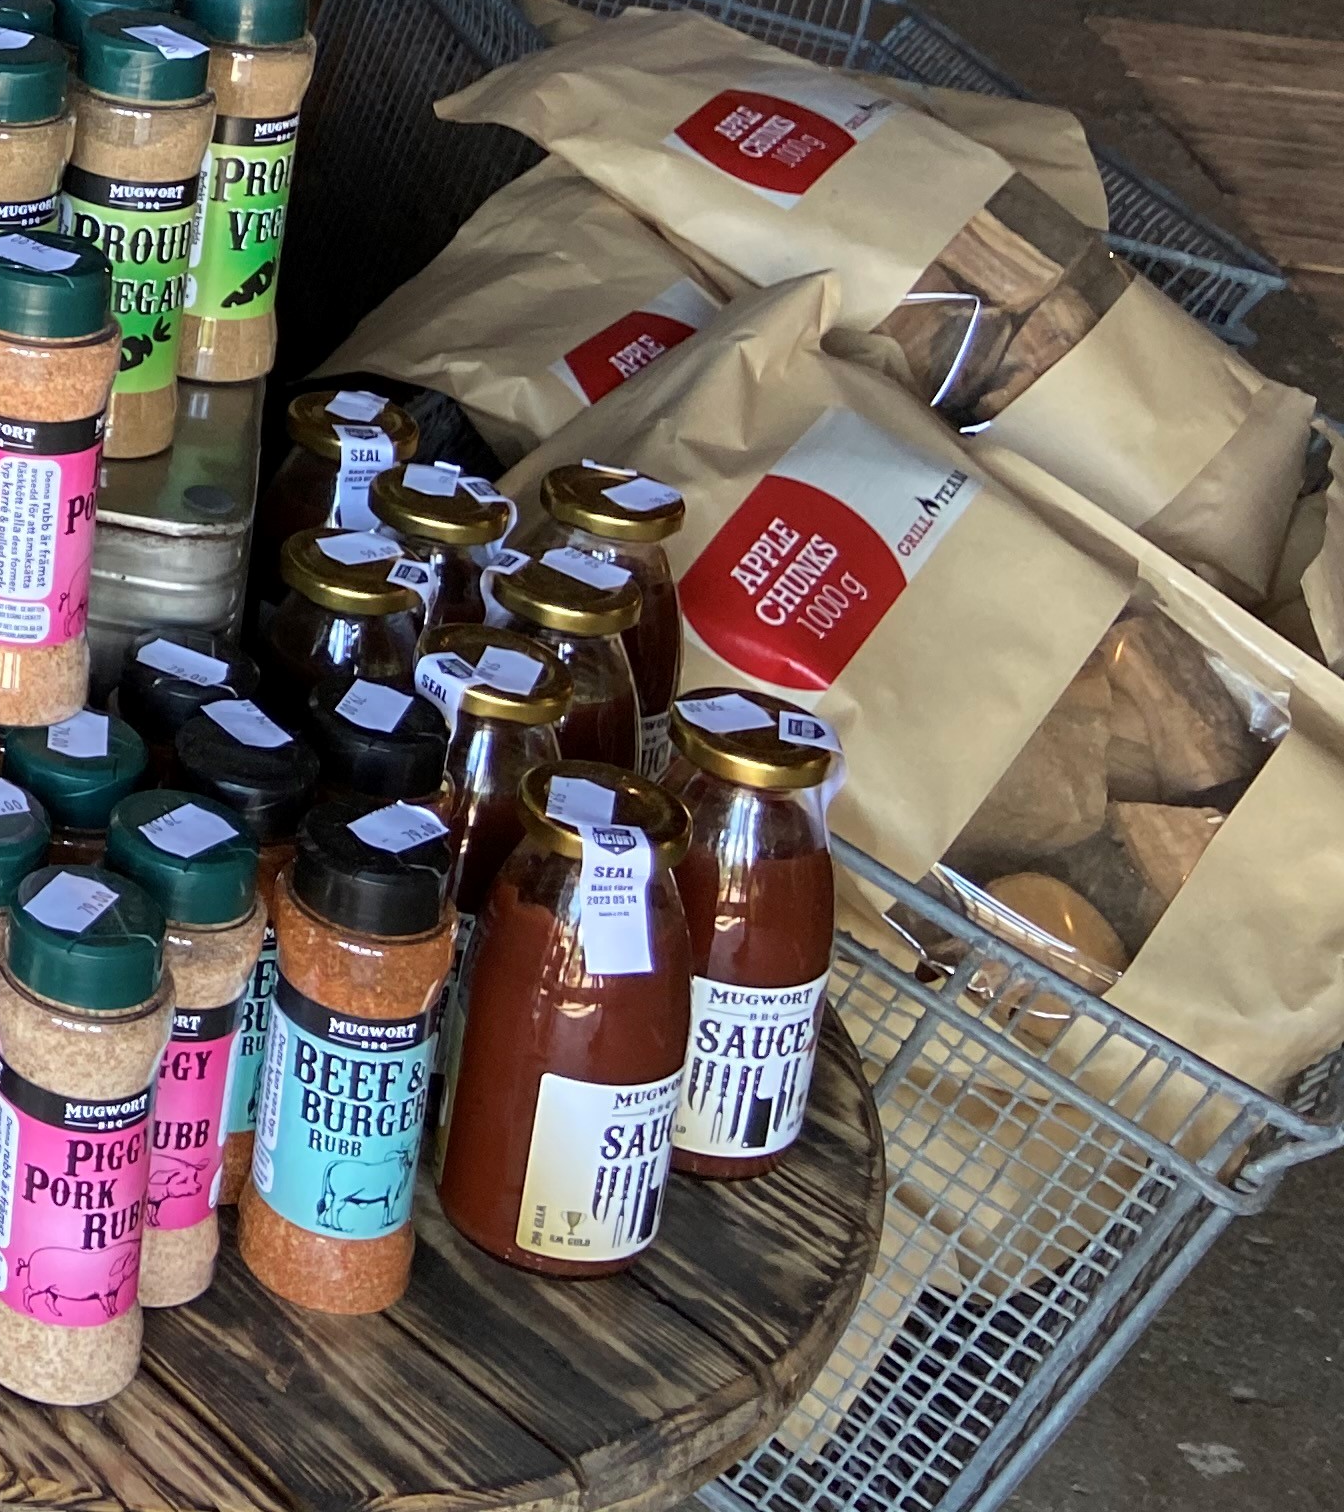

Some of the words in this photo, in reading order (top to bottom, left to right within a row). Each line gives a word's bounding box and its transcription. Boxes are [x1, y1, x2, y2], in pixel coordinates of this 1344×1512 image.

[714, 105, 763, 142] APPLE
[738, 114, 798, 159] CHUNKS
[109, 183, 185, 202] MUGWORT
[608, 334, 668, 379] APPLE
[1, 461, 12, 479] Typ
[350, 448, 381, 463] SEAL
[0, 481, 13, 513] karré
[14, 461, 27, 505] fläskkött
[29, 468, 39, 501] avsedd
[43, 470, 54, 500] Denna
[12, 512, 24, 534] alla
[28, 503, 39, 518] för
[40, 502, 53, 531] rubb
[896, 514, 938, 559] GRILL
[934, 469, 970, 510] TEAM
[27, 520, 37, 535] att
[40, 534, 50, 546] är
[11, 534, 20, 555] dess
[729, 516, 802, 596] APPLE
[22, 537, 36, 589] smaksätta
[36, 549, 50, 588] främst
[753, 533, 840, 628] CHUNKS
[794, 583, 852, 640] 1000
[841, 569, 869, 605] g
[421, 673, 448, 705] SEAL
[594, 833, 637, 846] FACTORY
[593, 866, 634, 879] SEAL
[76, 890, 113, 916] 79.00
[586, 896, 611, 906] 2023
[627, 895, 637, 905] 14
[708, 987, 813, 1006] MUGWORT
[328, 1017, 417, 1039] MUGWORT
[695, 1017, 811, 1060] SAUCE
[293, 1036, 405, 1103] BEEF
[407, 1061, 426, 1094] &
[64, 1094, 148, 1119] MUGWORT
[300, 1085, 428, 1139] BURGER
[307, 1127, 363, 1158] RUBB
[21, 1162, 118, 1210] PORK
